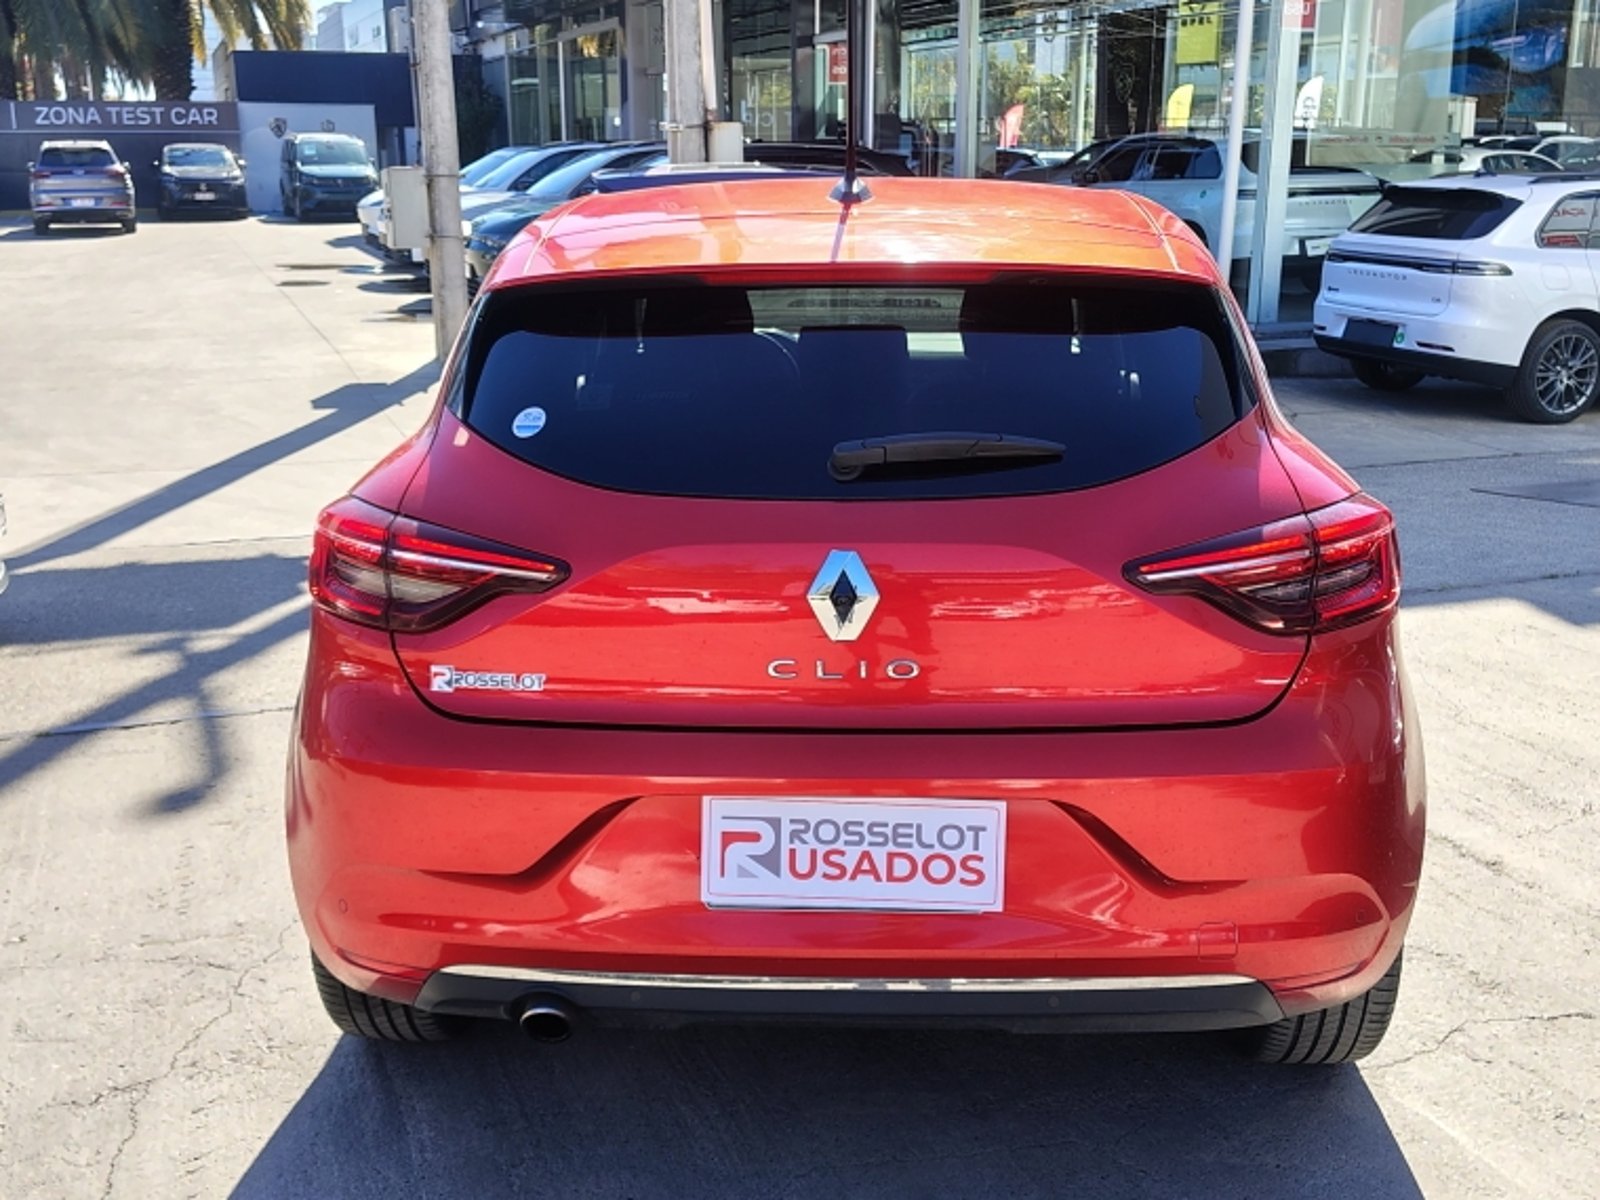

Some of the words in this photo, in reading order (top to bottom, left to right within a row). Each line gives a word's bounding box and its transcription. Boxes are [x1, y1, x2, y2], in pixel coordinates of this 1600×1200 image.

[34, 106, 101, 125] ZONA
[106, 106, 164, 125] TEST
[170, 107, 218, 125] CAR
[766, 658, 921, 680] CLIO
[453, 672, 545, 690] ROSSELOT
[788, 818, 987, 851] ROSSELOT
[788, 848, 986, 887] USADOS
